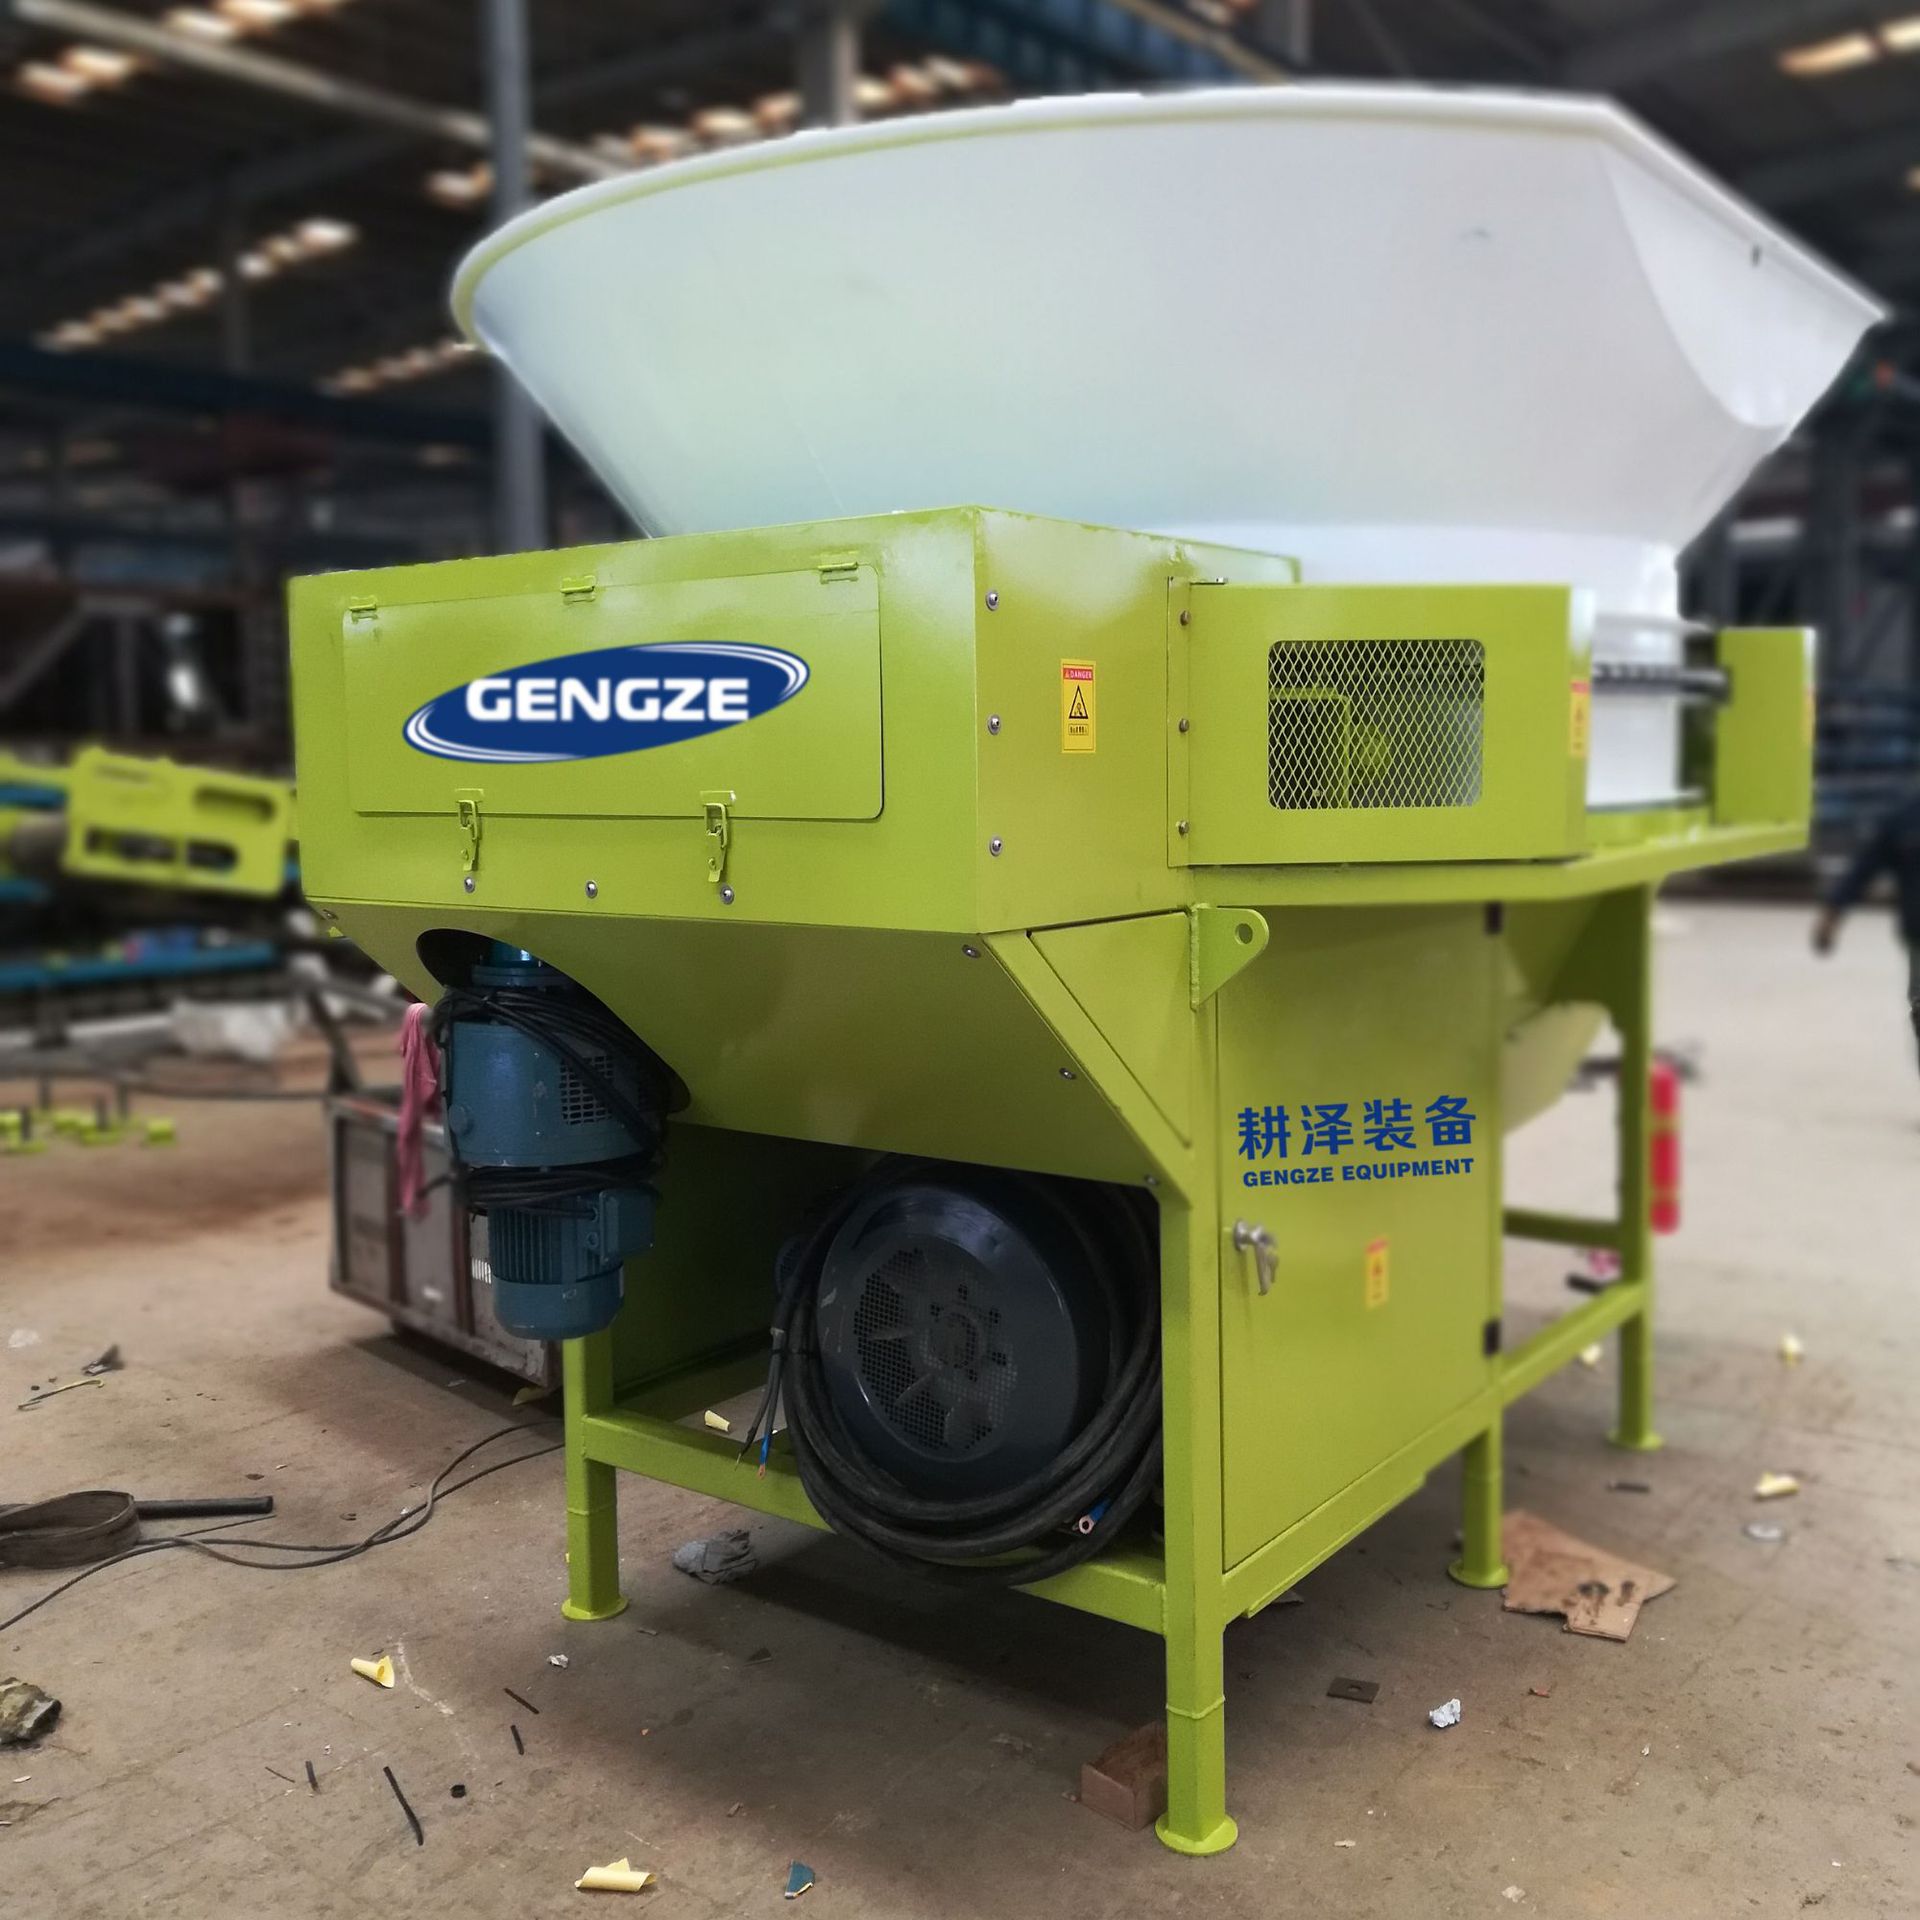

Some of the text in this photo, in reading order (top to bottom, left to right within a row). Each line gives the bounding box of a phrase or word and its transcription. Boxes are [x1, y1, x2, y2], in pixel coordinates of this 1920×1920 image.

[1070, 670, 1092, 679] DANGER
[466, 678, 749, 721] GENGZE
[1238, 1095, 1476, 1160] 耕泽装备
[1243, 1158, 1474, 1187] GENGZE EQUIPMENT
